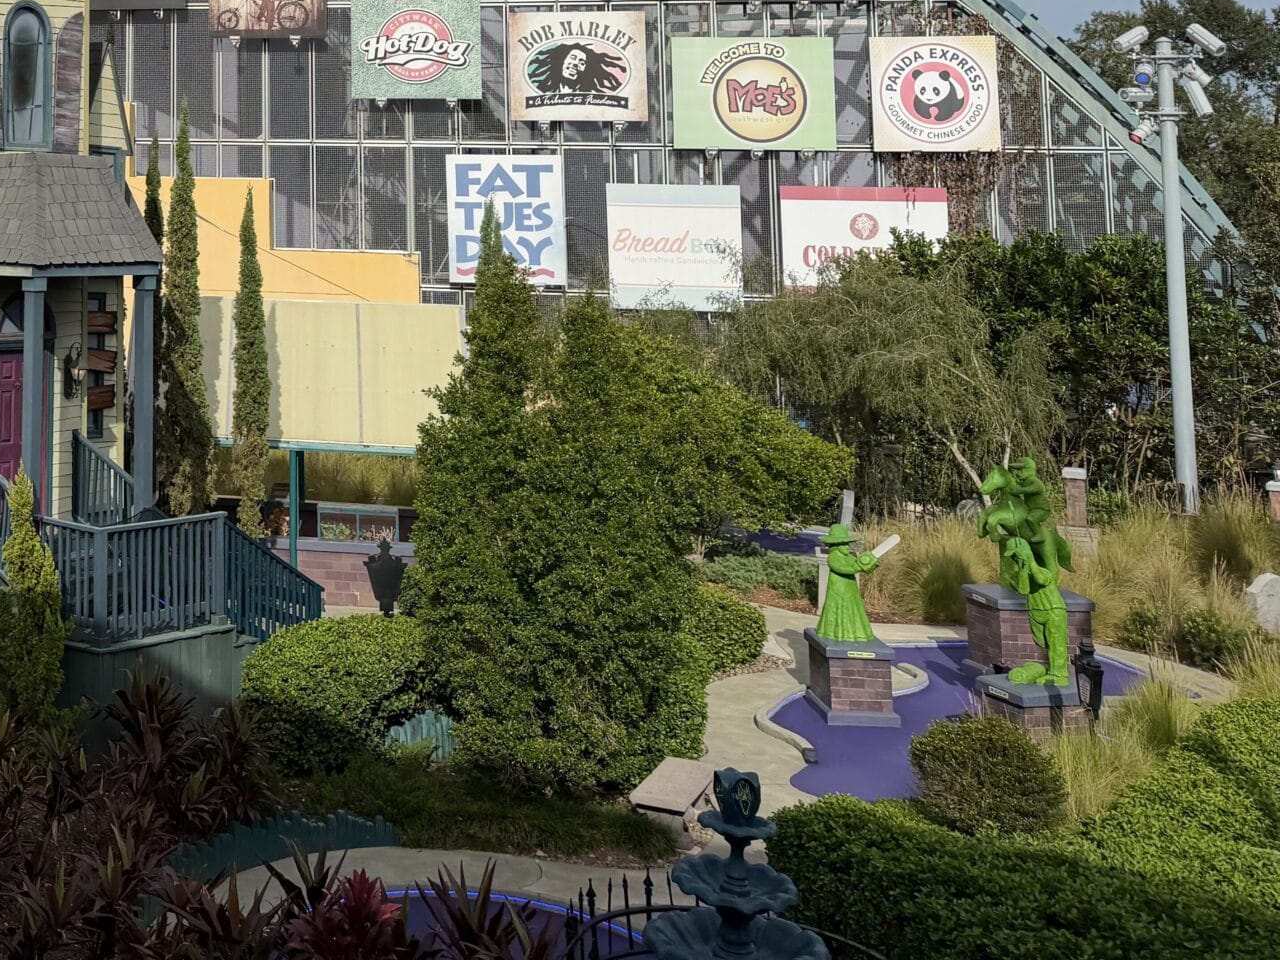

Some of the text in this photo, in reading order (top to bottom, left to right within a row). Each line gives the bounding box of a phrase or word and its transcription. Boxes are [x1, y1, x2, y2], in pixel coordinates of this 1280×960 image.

[389, 14, 441, 30] CITYWALK
[517, 20, 637, 53] BOB MARLEY
[700, 42, 785, 84] WELCOME TO
[885, 48, 984, 92] PANDA EXPRESS
[543, 95, 572, 105] Tribute
[573, 95, 583, 104] to
[584, 95, 618, 106] Freedom
[888, 103, 983, 140] GOURMET CHINESE FOOD
[455, 162, 553, 198] FAT
[612, 227, 690, 254] Bread
